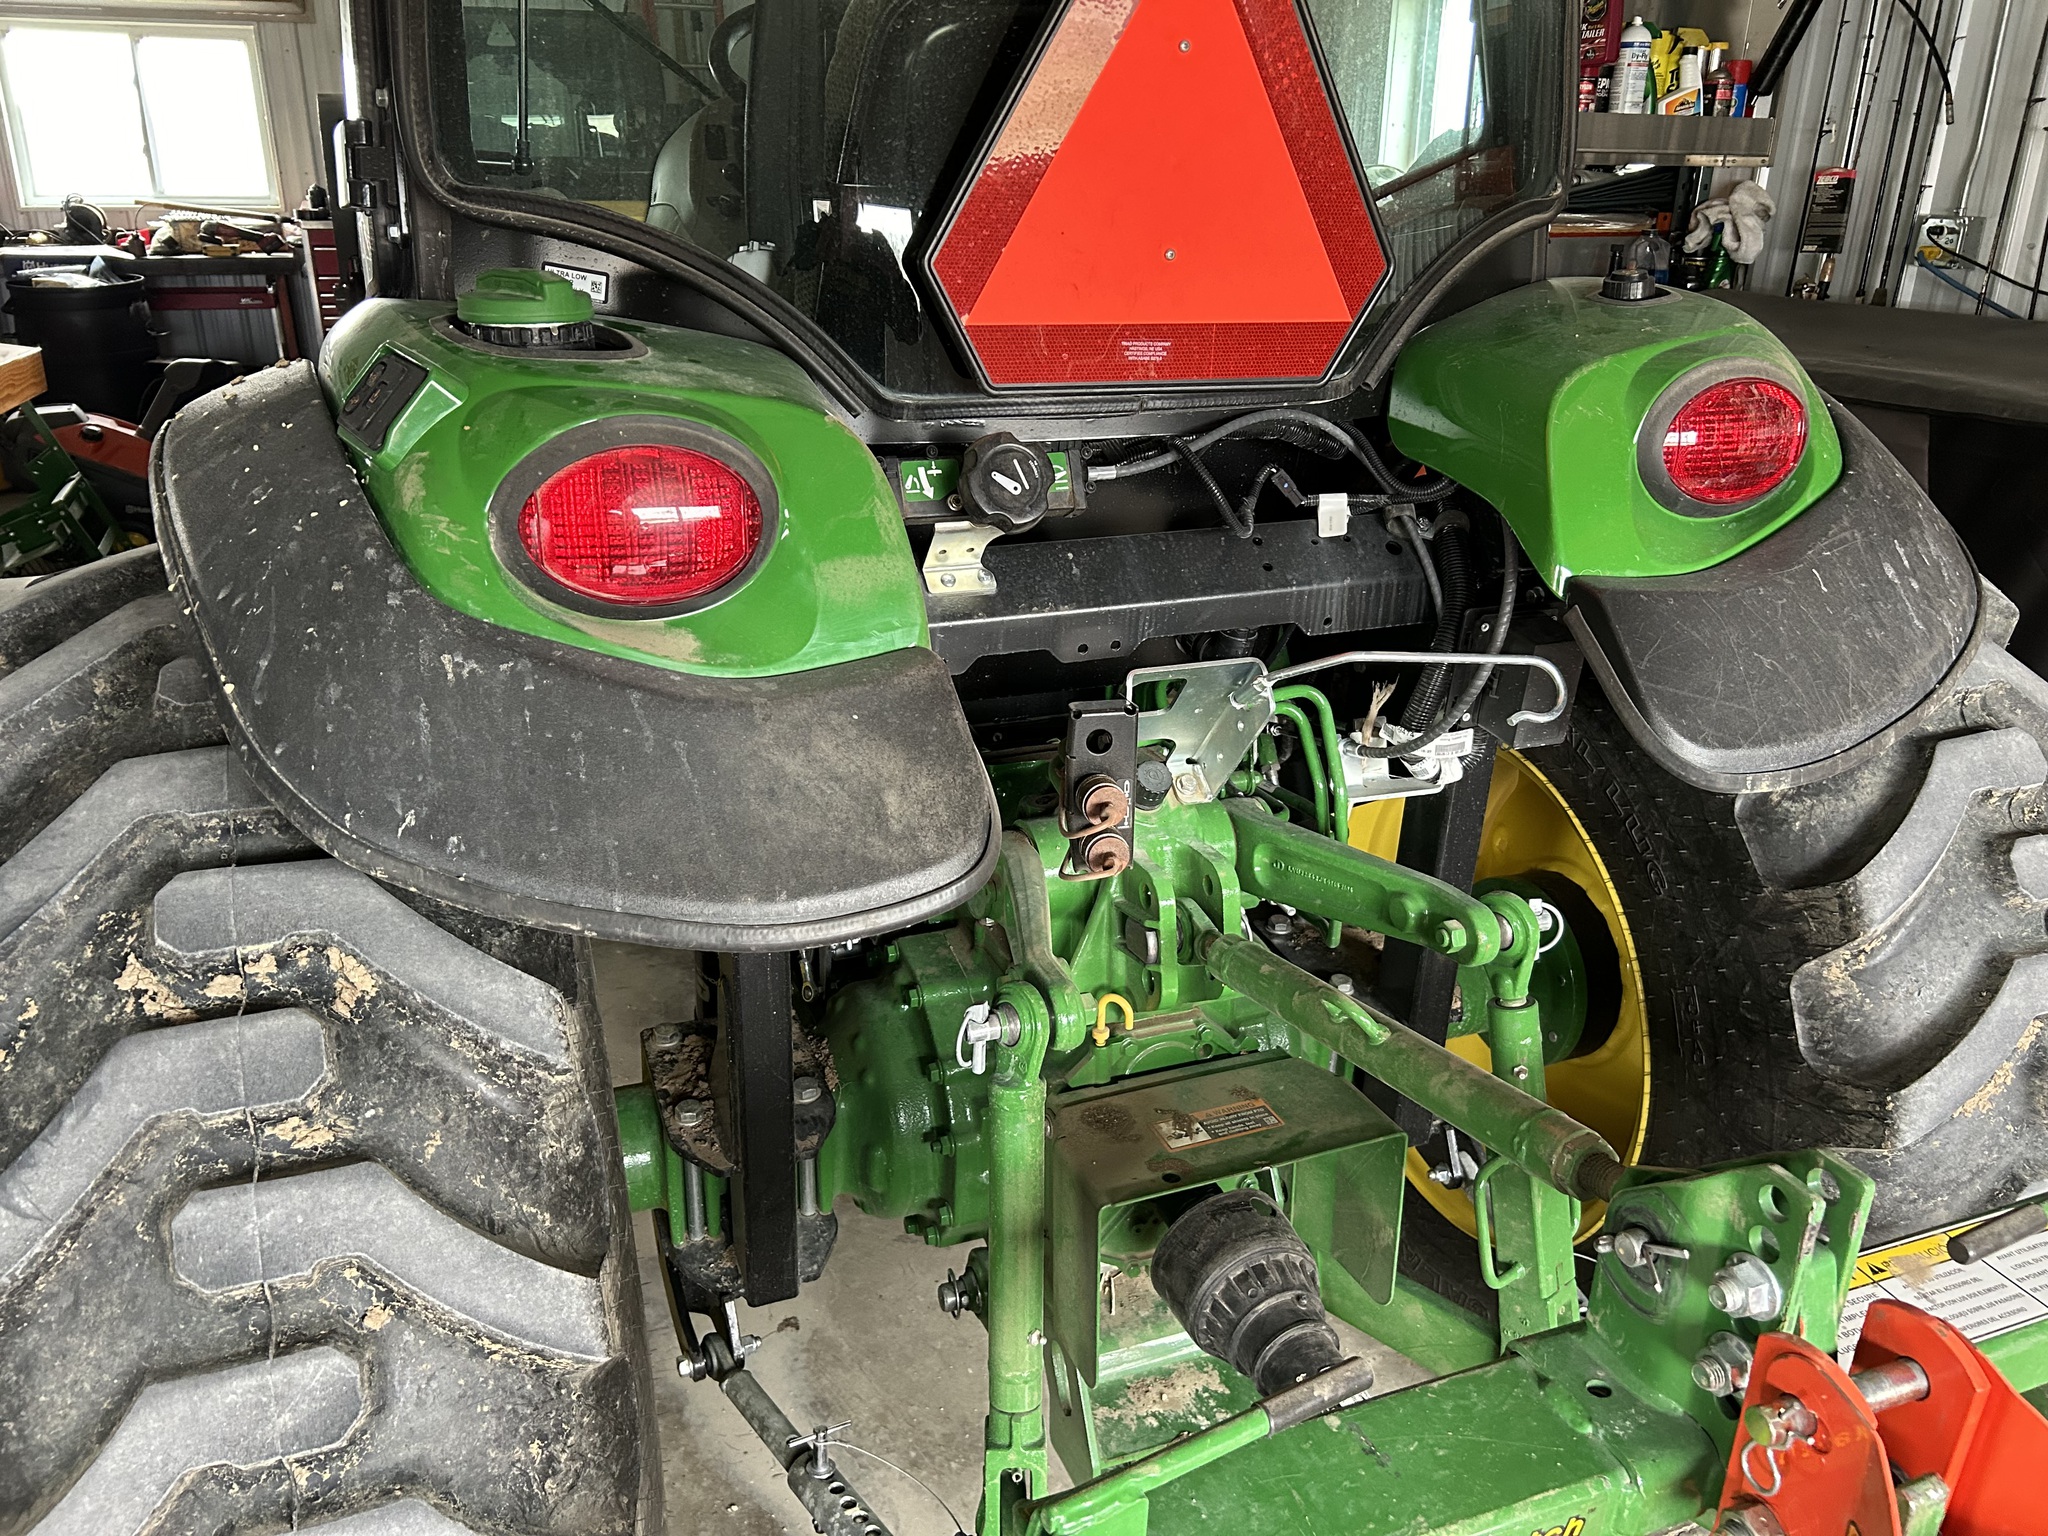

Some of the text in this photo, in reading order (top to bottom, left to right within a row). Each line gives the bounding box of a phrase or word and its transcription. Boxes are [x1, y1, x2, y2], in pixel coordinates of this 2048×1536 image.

[1212, 1102, 1256, 1116] WARNING
[1996, 1251, 2016, 1260] AVANT
[1847, 1292, 1880, 1306] SECURE
[1842, 1310, 1868, 1322] IMPLE
